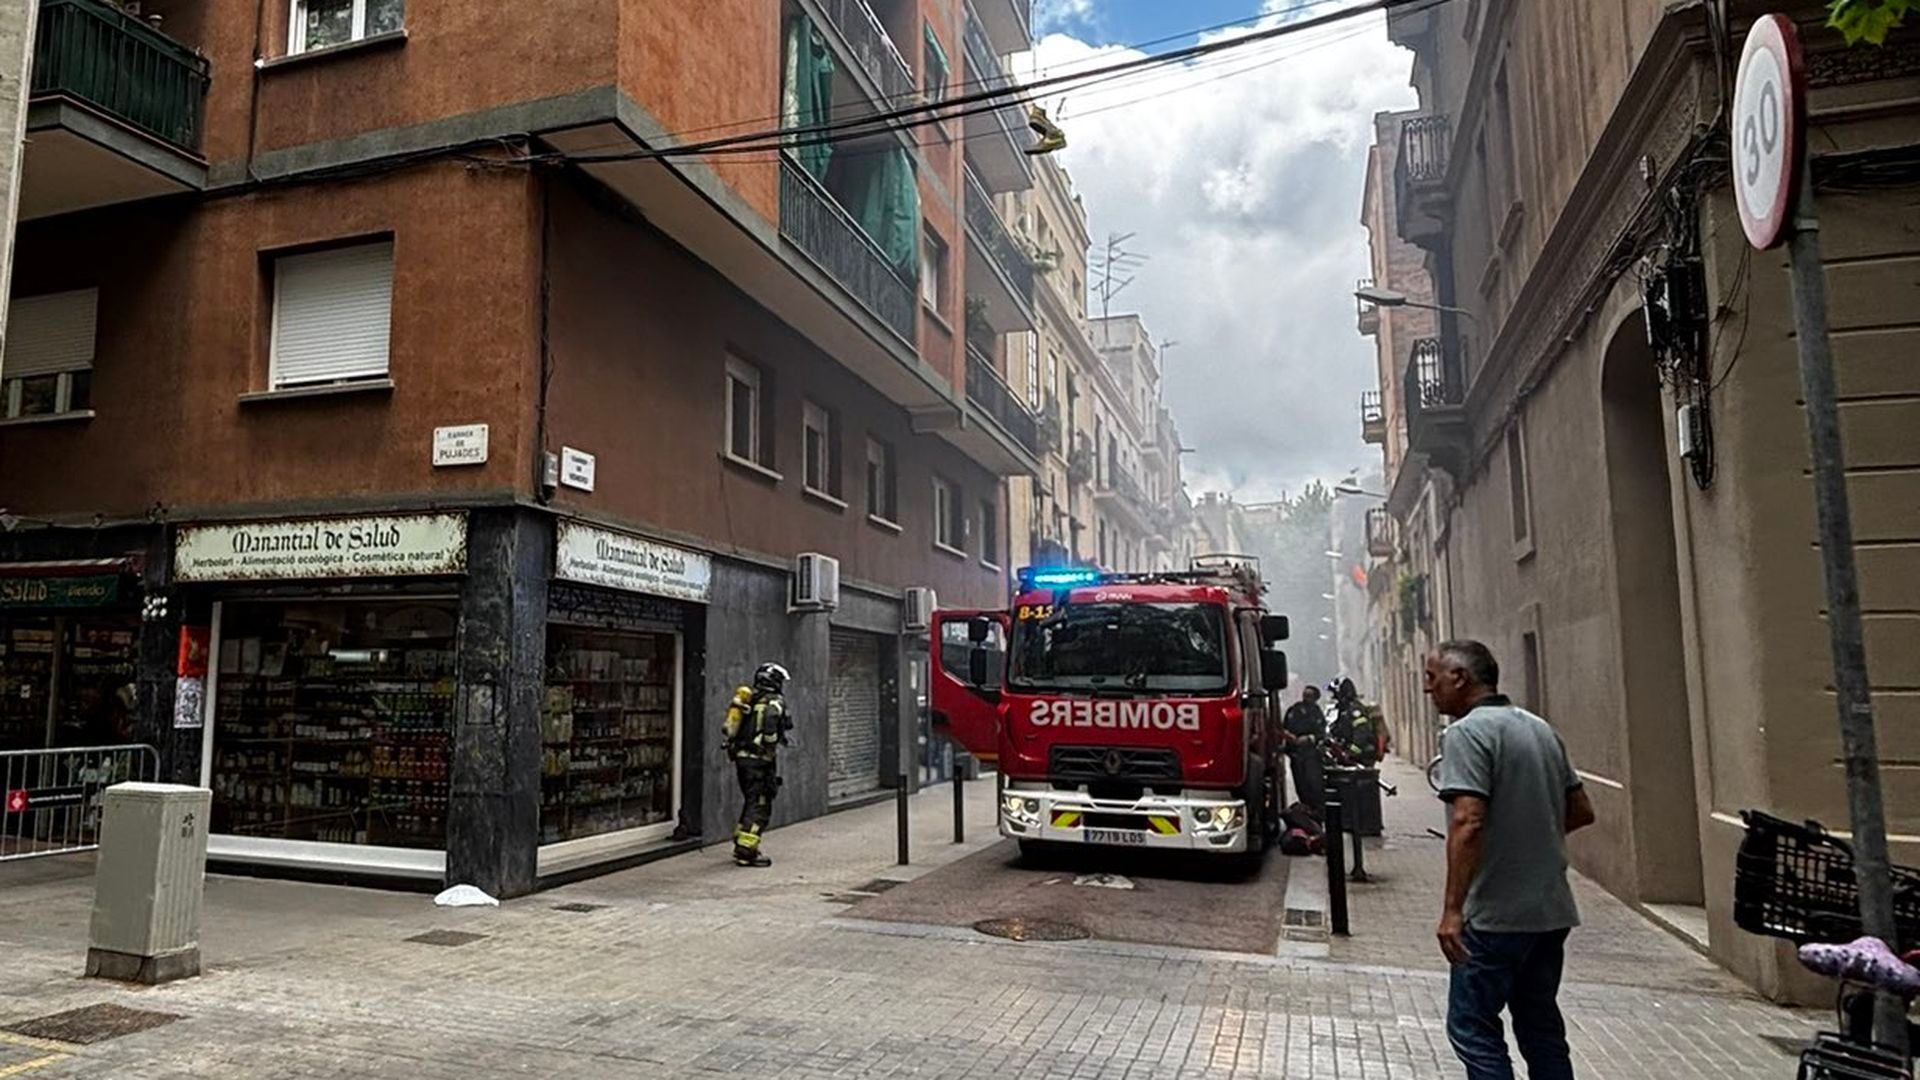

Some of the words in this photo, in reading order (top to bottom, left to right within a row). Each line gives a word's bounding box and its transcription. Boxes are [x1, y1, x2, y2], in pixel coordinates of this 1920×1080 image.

[1744, 80, 1778, 187] 30
[439, 447, 480, 460] PUJADES
[232, 526, 319, 553] Manantial
[324, 530, 343, 549] de
[347, 523, 400, 552] Salud
[408, 549, 444, 561] natural
